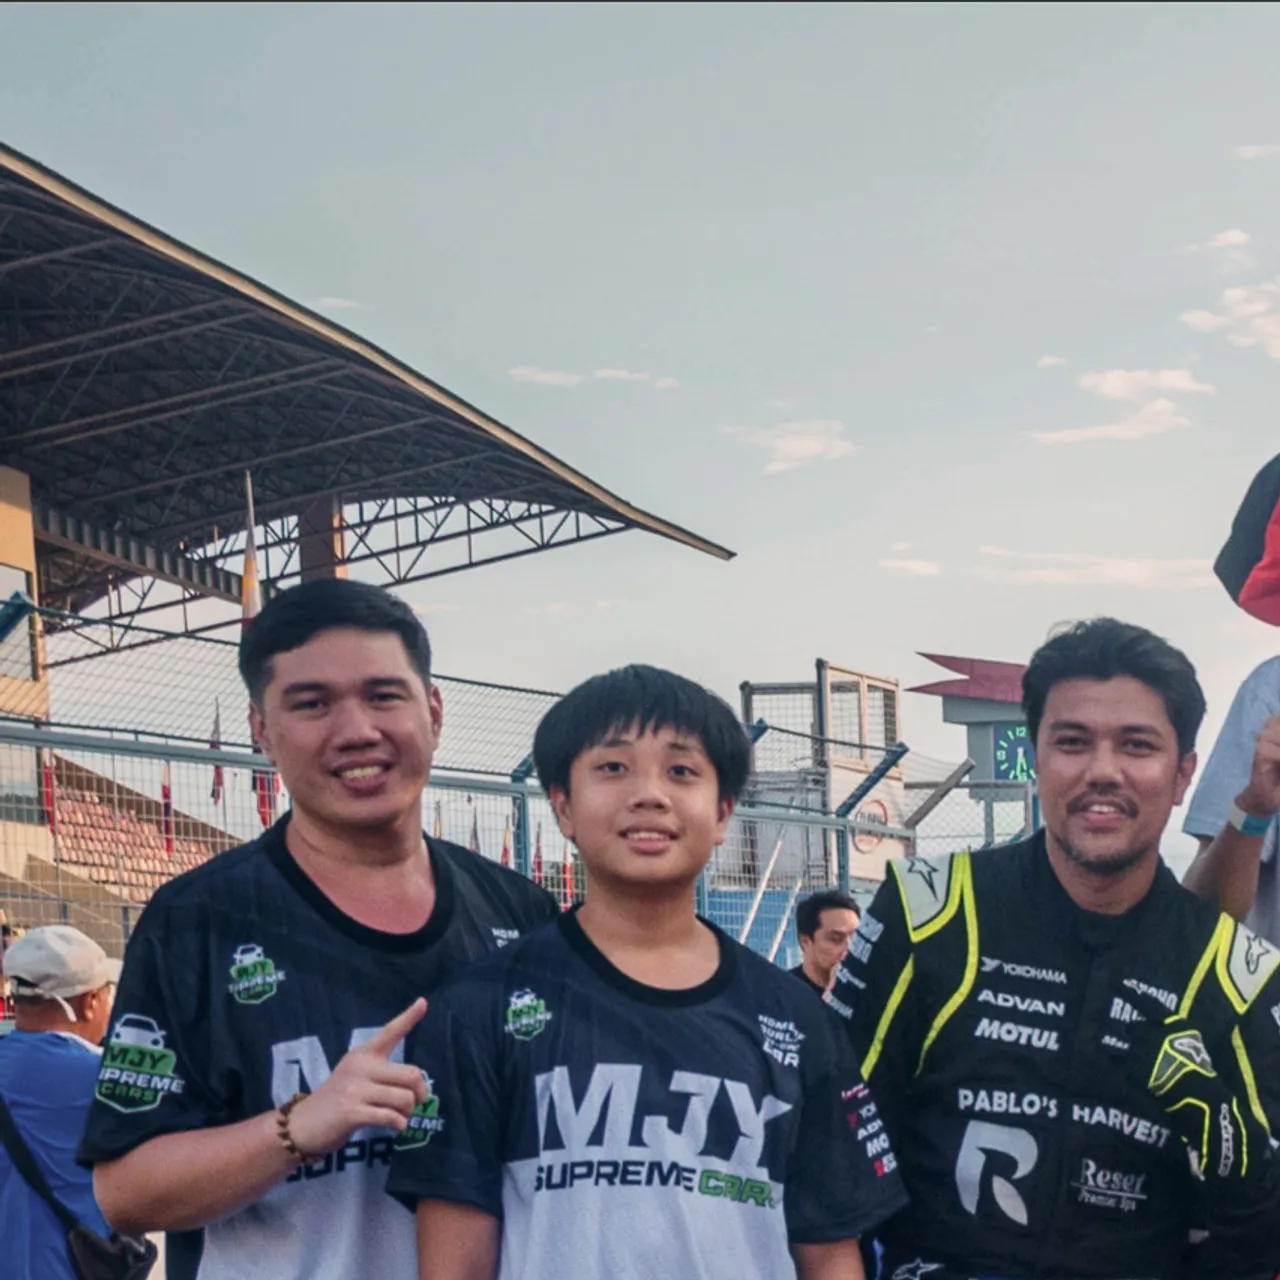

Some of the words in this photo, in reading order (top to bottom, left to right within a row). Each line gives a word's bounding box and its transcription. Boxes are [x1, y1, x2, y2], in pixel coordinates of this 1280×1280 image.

[1002, 961, 1067, 985] YOKOHAMA
[977, 988, 1065, 1017] ADVAN
[974, 1018, 1060, 1052] MOTUL
[103, 1047, 168, 1070] MJY
[534, 1062, 795, 1169] MJY
[957, 1088, 1058, 1118] PABLO'S
[1071, 1104, 1172, 1148] HARVEST
[534, 1160, 697, 1193] SUPREME
[1080, 1157, 1146, 1194] Reset
